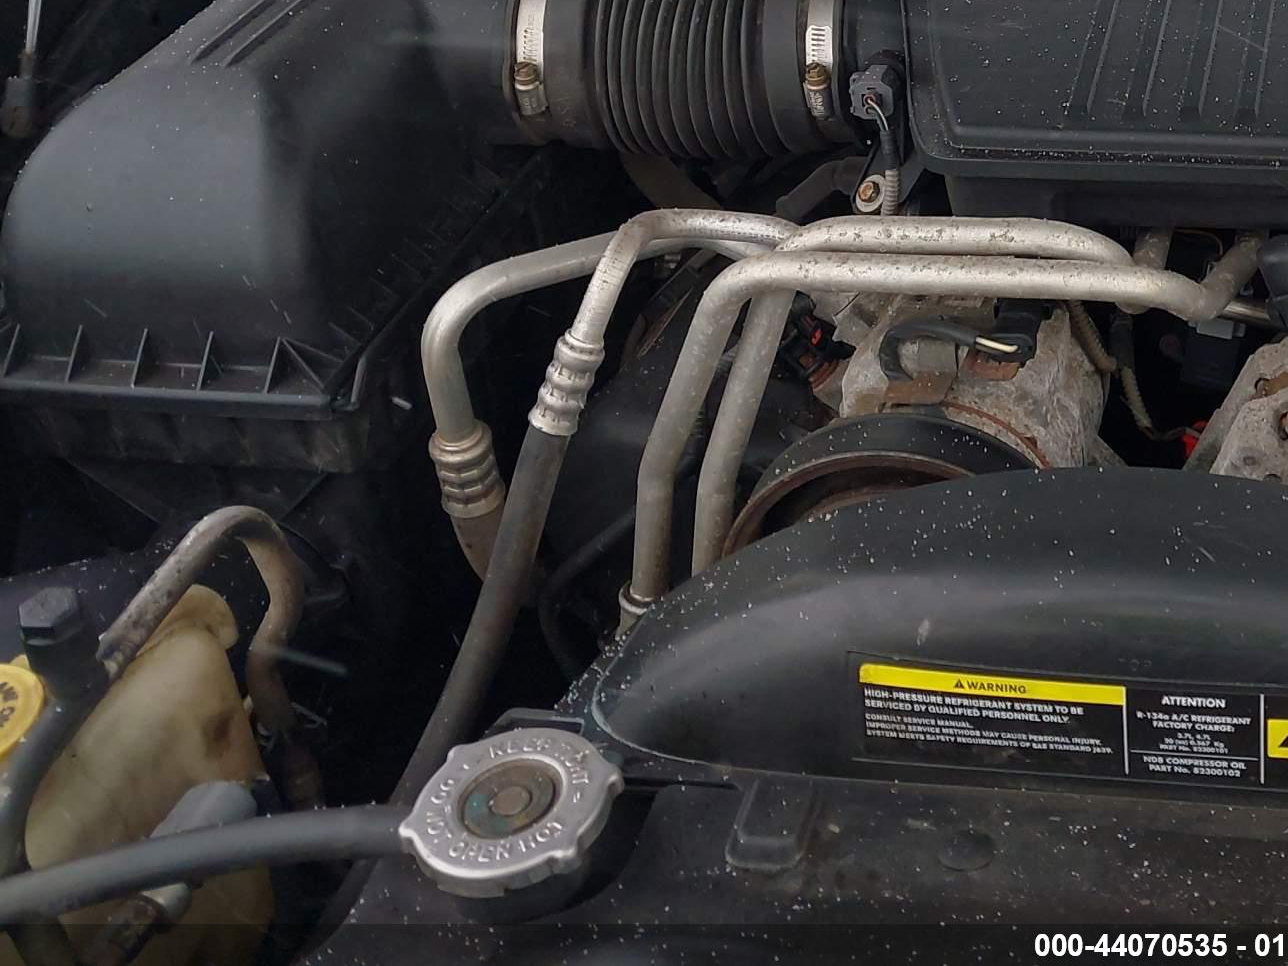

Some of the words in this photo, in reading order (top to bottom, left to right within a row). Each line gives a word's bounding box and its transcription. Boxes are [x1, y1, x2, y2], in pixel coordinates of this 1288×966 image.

[967, 681, 1026, 694] WARNING
[864, 687, 943, 704] HIGH-PRESSURE
[944, 696, 1012, 710] REFRIGERANT
[1014, 702, 1053, 713] SYSTEM
[1055, 705, 1068, 714] TO
[1070, 706, 1084, 715] BE
[1161, 695, 1227, 708] ATTENTION
[864, 699, 912, 711] SERVICED
[913, 704, 926, 712] BY
[928, 706, 980, 717] QUALIFIED
[982, 710, 1041, 723] PERSONNEL
[865, 713, 902, 723] CONSULT
[903, 717, 935, 725] SERVICE
[1136, 711, 1169, 721] R-134a
[1171, 713, 1189, 721] A/C
[1191, 714, 1251, 725] REFRIGERANT
[865, 721, 906, 731] IMPROPER
[908, 725, 940, 734] SERVICE
[942, 728, 980, 737] METHODS
[981, 730, 999, 738] MAY
[1001, 732, 1027, 740] CAUSE
[1028, 734, 1070, 743] PERSONAL
[1152, 721, 1193, 730] FACTORY
[866, 729, 897, 738] SYSTEM
[898, 732, 925, 740] MEETS
[926, 735, 955, 743] SAFETY
[956, 737, 1018, 747] REQUIREMENTS
[1049, 743, 1091, 753] STANDARD
[1149, 764, 1172, 773] PART
[1174, 765, 1190, 774] No.
[1166, 757, 1228, 768] COMPRESSOR
[1230, 761, 1247, 770] OIL
[448, 841, 510, 863] OPEN
